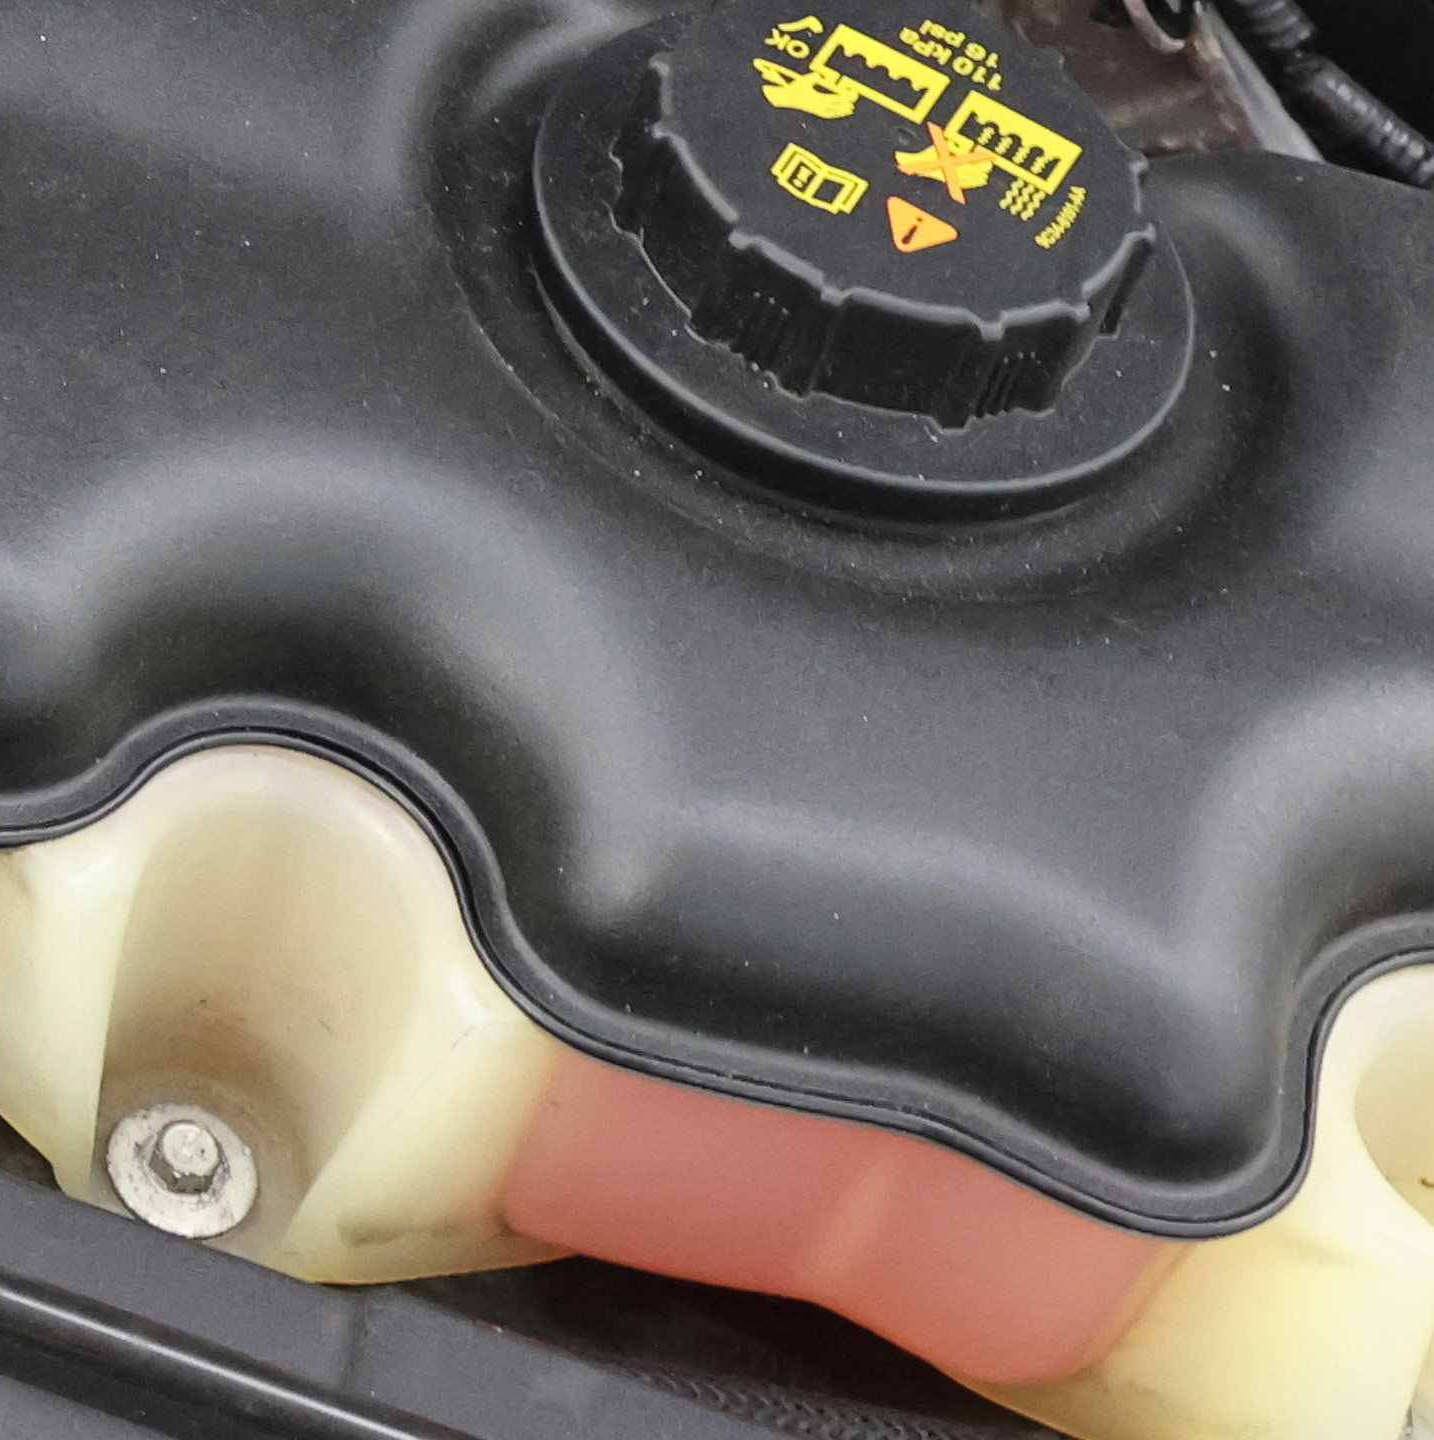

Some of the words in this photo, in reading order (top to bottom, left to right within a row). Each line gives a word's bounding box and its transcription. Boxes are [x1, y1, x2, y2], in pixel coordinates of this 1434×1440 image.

[764, 27, 810, 59] OK
[899, 27, 953, 66] kPa
[919, 20, 966, 48] psi
[965, 42, 999, 69] 16
[951, 56, 1003, 92] 110
